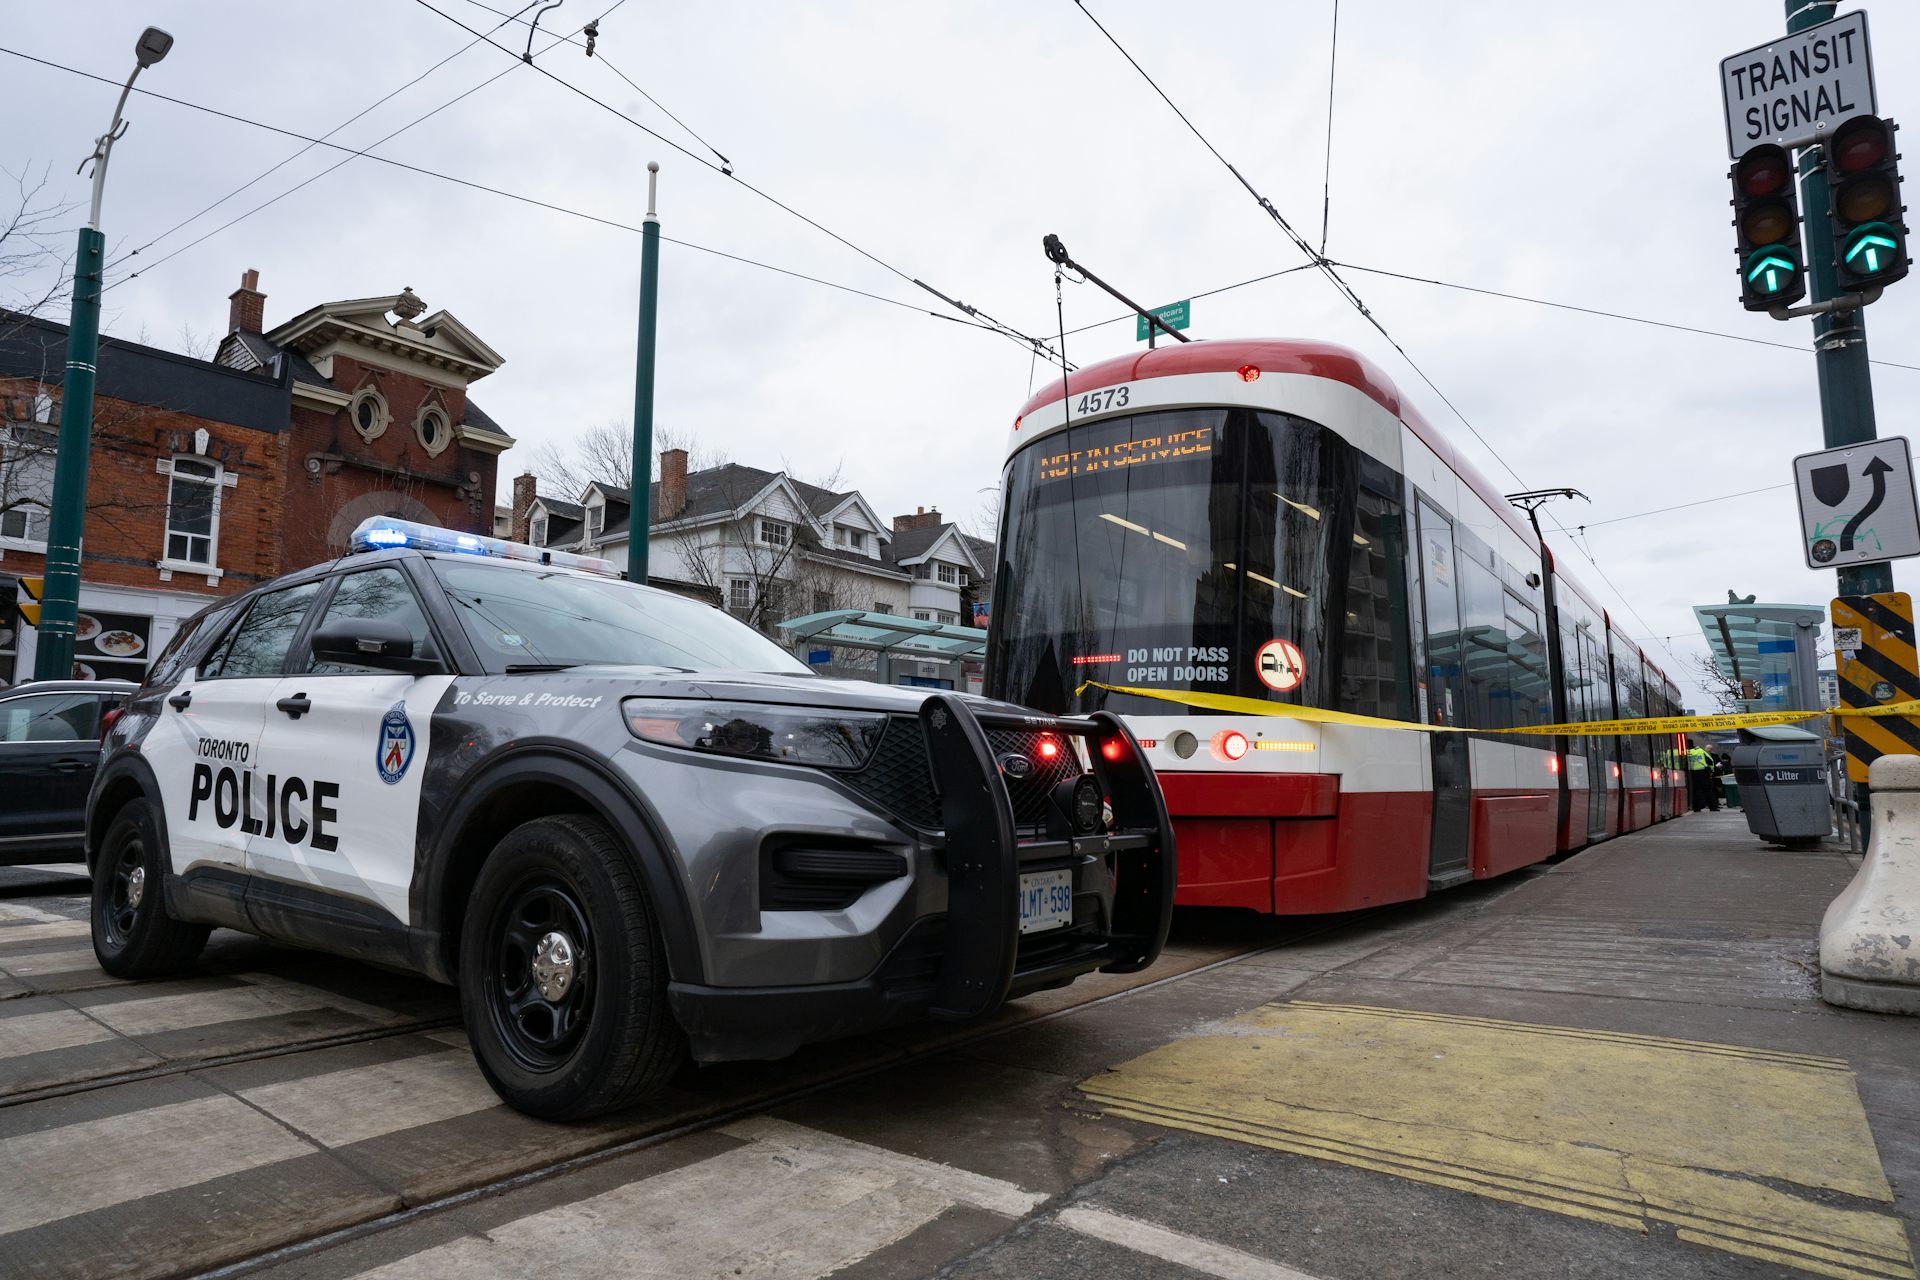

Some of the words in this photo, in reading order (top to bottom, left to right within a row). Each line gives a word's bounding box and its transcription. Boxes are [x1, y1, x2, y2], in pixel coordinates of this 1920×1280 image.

[1731, 28, 1856, 100] TRANSIT
[1746, 79, 1855, 140] SIGNAL
[1077, 386, 1130, 415] 4573
[1041, 451, 1082, 479] NOT
[1086, 447, 1110, 472] IN
[1114, 427, 1211, 466] SERVICE
[1127, 649, 1146, 663] DO
[1153, 648, 1184, 663] NOT
[1187, 647, 1230, 662] PASS
[1127, 667, 1168, 682] OPEN
[1173, 666, 1229, 682] DOORS
[453, 692, 472, 705] To
[473, 692, 517, 705] Serve
[518, 693, 534, 706] &
[533, 693, 603, 708] Protect
[1023, 716, 1057, 726] SETINA
[198, 737, 250, 763] TORONTO
[1776, 770, 1800, 781] Litter
[188, 763, 340, 853] POLICE
[1050, 885, 1071, 913] 598
